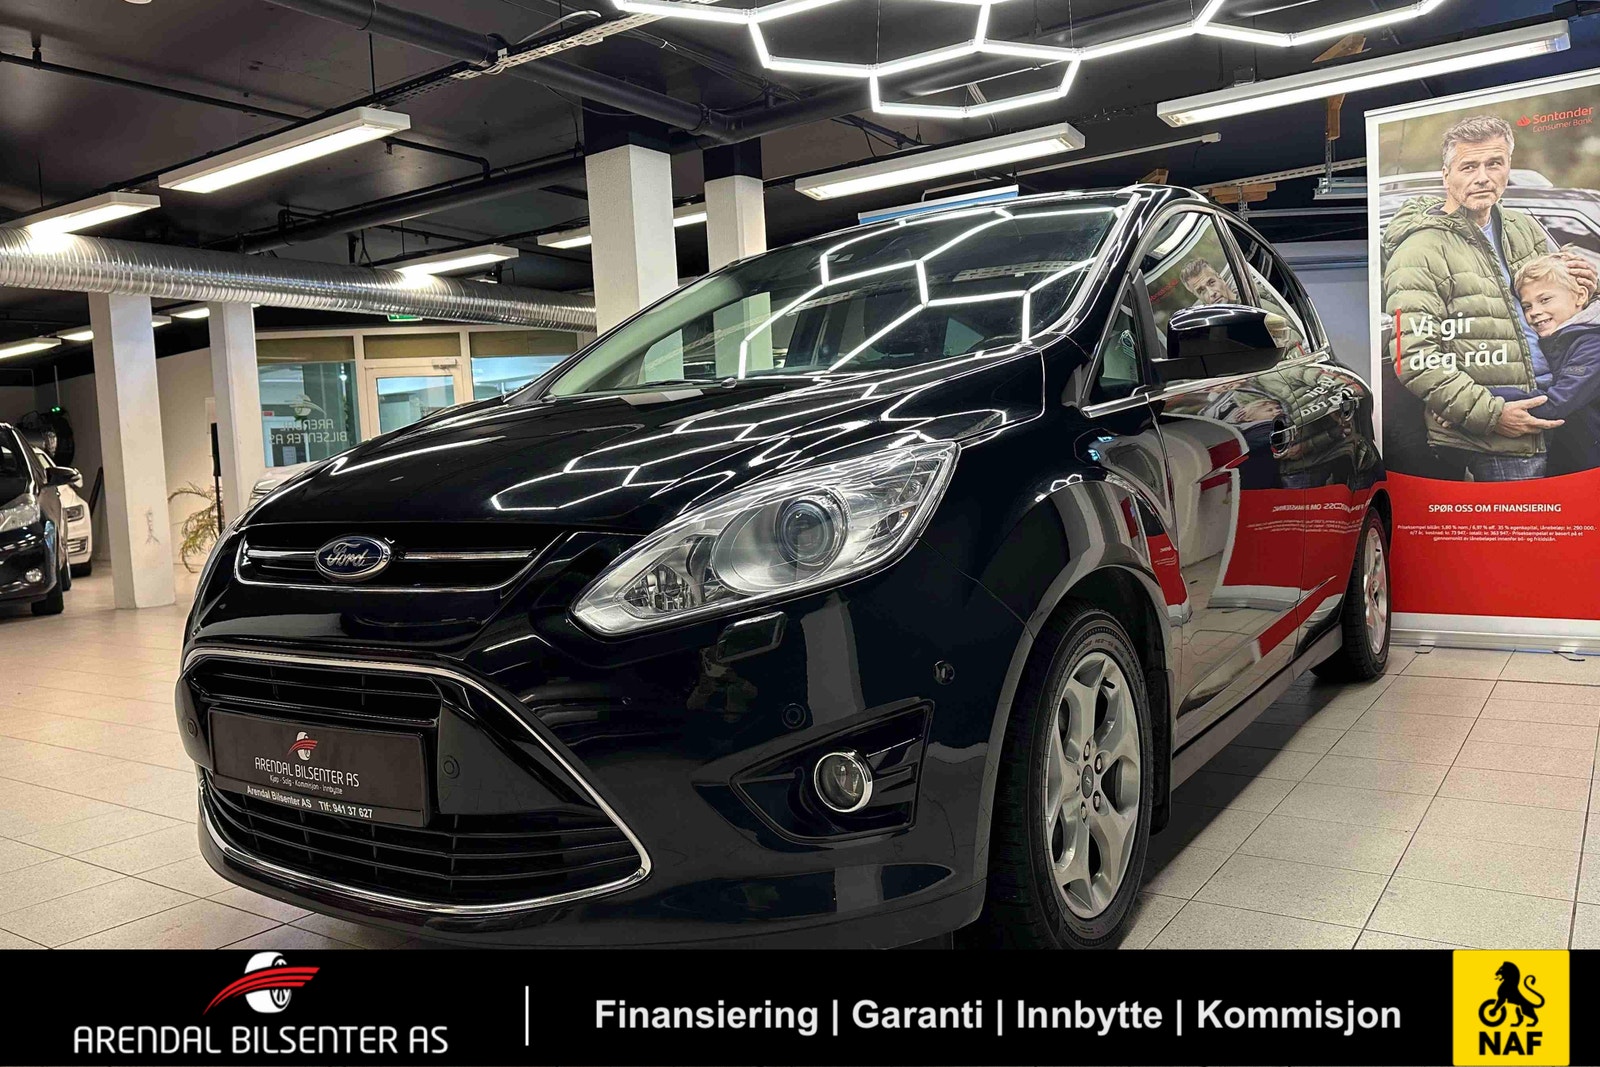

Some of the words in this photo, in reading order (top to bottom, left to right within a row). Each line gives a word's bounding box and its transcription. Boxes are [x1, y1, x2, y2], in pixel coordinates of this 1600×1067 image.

[1532, 106, 1594, 125] Santander
[1532, 120, 1571, 133] Consumer
[1573, 117, 1593, 127] Bank
[1408, 315, 1433, 337] Vi
[1440, 312, 1476, 341] gir
[1409, 348, 1457, 374] deg
[1464, 342, 1508, 367] råd
[1428, 504, 1453, 513] SPØR
[1455, 504, 1473, 512] OSS
[1475, 504, 1491, 512] OM
[1493, 504, 1562, 512] FINANSIERING
[324, 542, 370, 567] Ford
[255, 756, 293, 777] ARENDAL
[295, 764, 344, 785] BILSENTER
[346, 772, 360, 787] AS
[246, 786, 270, 799] Arendal
[271, 791, 300, 804] Bilsenter
[301, 799, 312, 808] AS
[318, 801, 331, 811] Tlf:
[332, 803, 346, 814] 941
[347, 806, 357, 815] 37
[358, 808, 373, 818] 627
